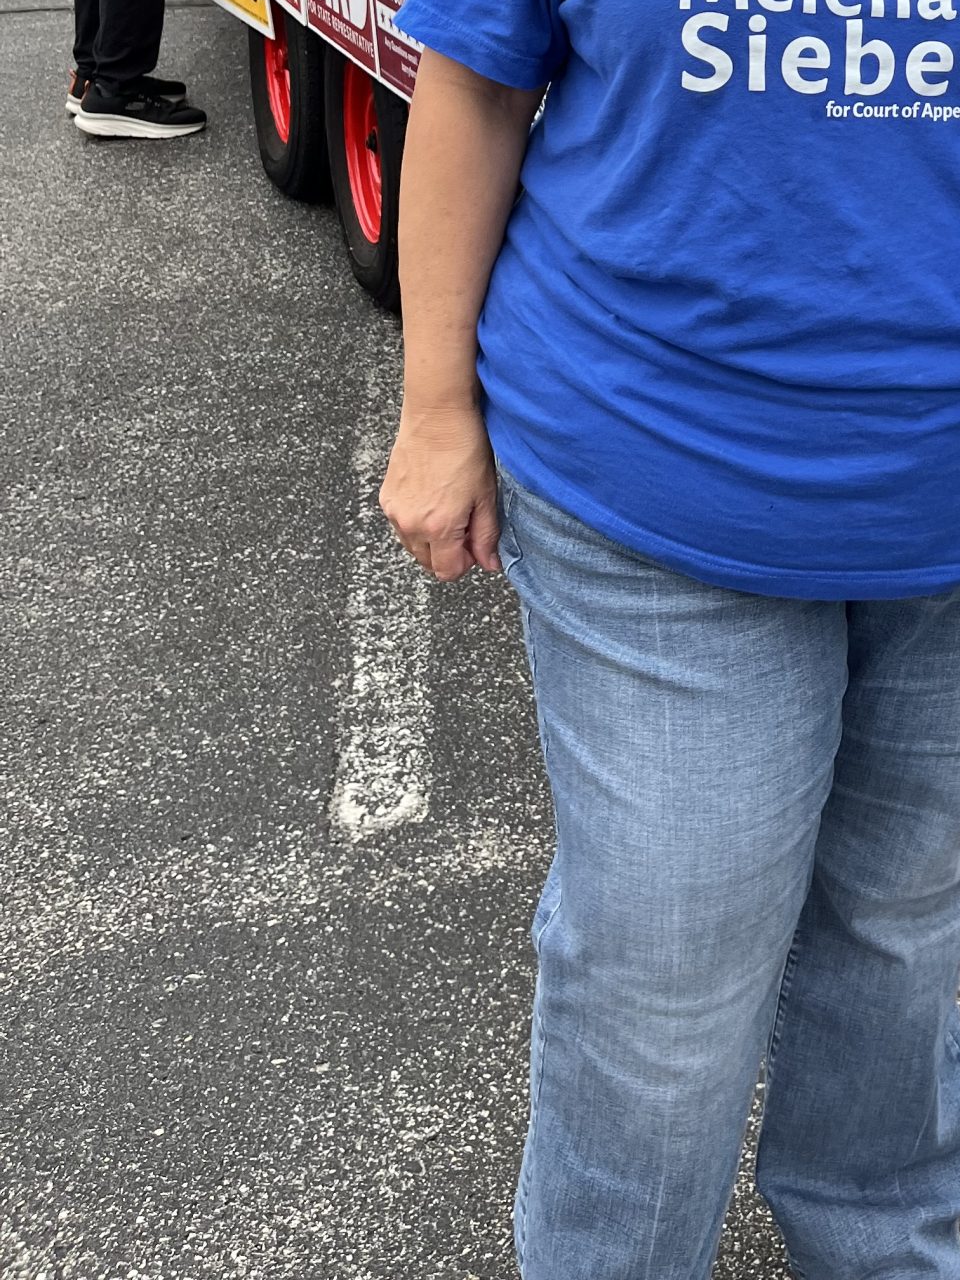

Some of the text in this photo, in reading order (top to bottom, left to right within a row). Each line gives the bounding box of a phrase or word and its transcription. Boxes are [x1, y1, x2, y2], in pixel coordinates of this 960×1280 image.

[316, 3, 332, 27] STATE
[331, 13, 375, 59] REPRESENTATIVE
[826, 100, 850, 118] for
[852, 102, 900, 118] Court
[901, 101, 921, 118] of
